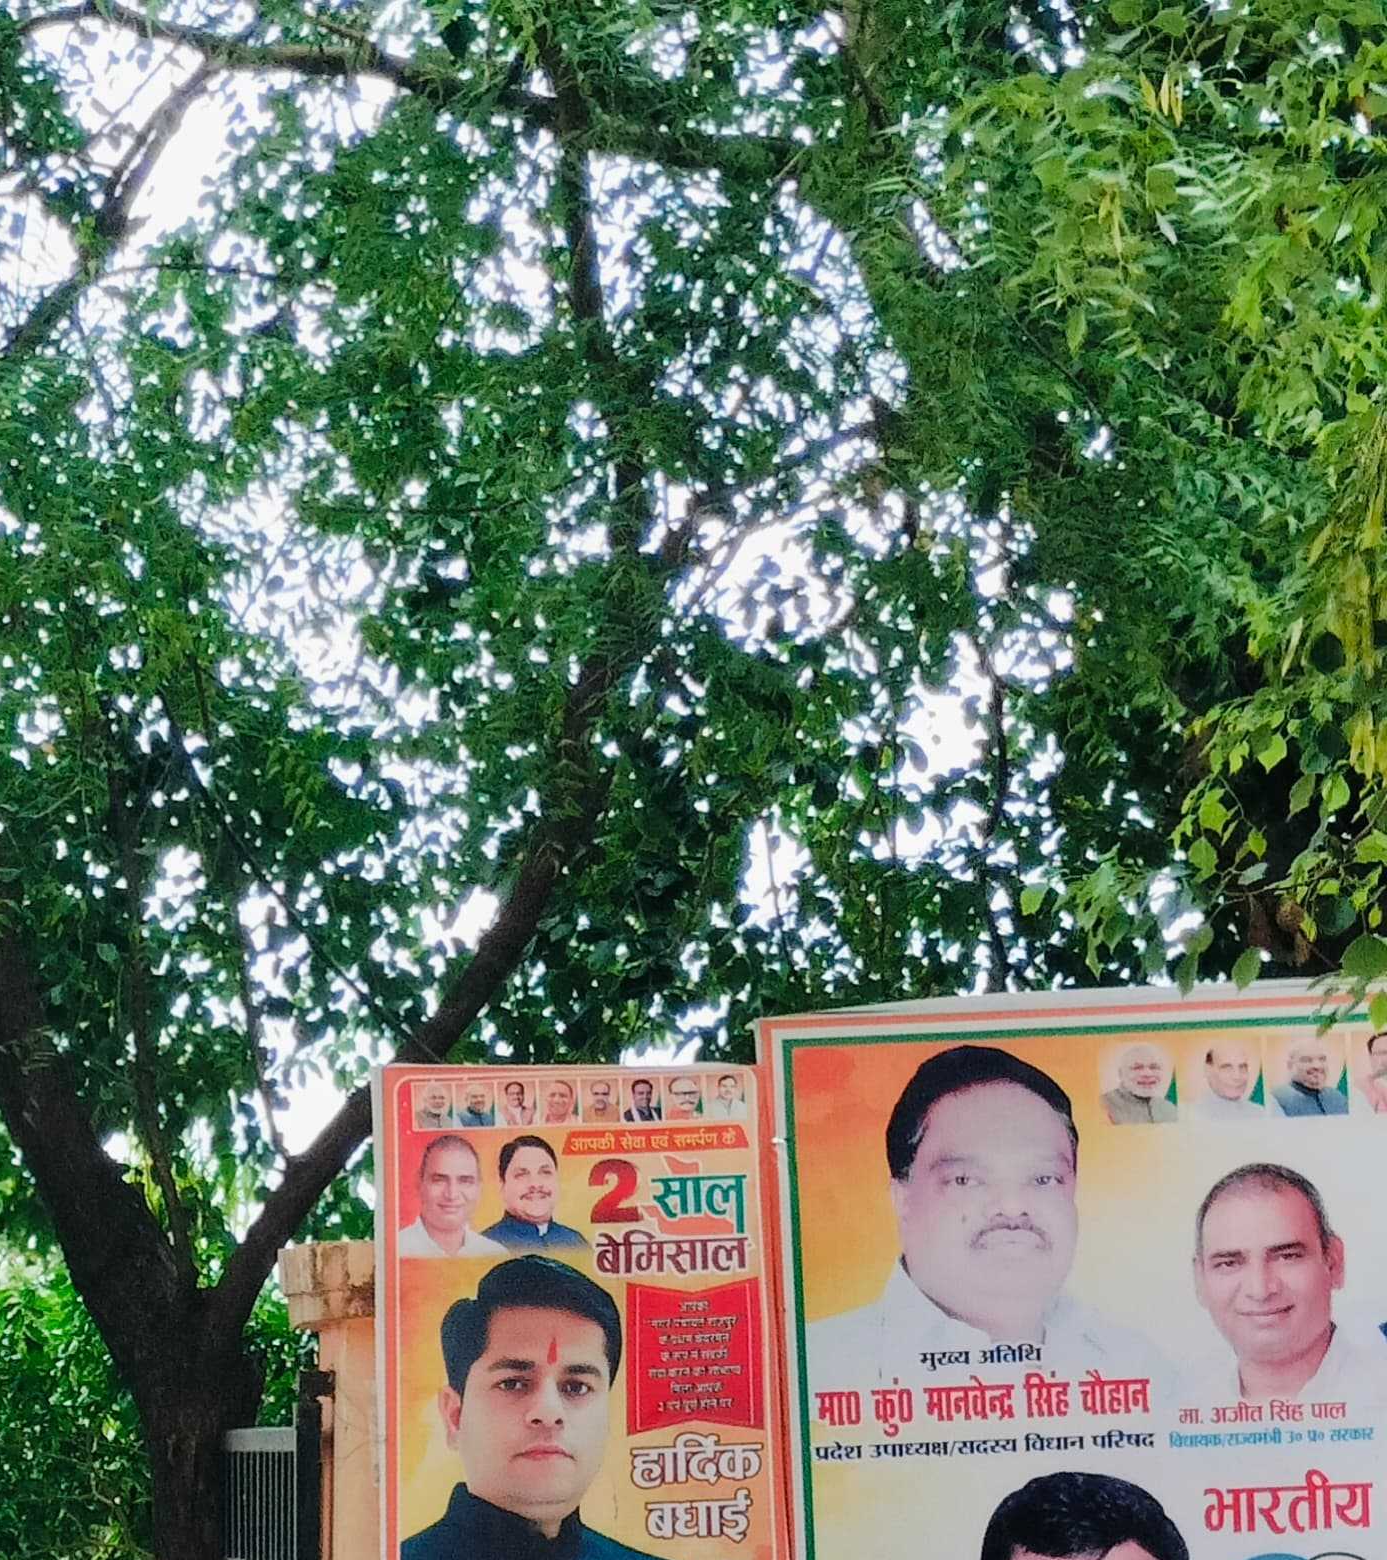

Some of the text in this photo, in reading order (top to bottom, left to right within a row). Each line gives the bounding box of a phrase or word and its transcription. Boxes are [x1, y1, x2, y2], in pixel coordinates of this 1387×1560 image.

[570, 1131, 615, 1152] आपकी
[619, 1131, 646, 1150] सेवा
[722, 1127, 737, 1145] के
[588, 1158, 748, 1234] 2 साल
[595, 1229, 749, 1274] बेमिसाल
[919, 1343, 1042, 1372] मुख्य अतिथि
[923, 1375, 1015, 1422] मानवेन्द्र
[1024, 1371, 1070, 1418] सिंह
[1078, 1369, 1151, 1416] चौहान
[1210, 1400, 1263, 1424] अजीत
[1269, 1398, 1304, 1422] सिंह
[1311, 1401, 1347, 1420] पाल
[630, 1431, 764, 1490] हार्दिक
[815, 1441, 863, 1461] प्रदेश
[1024, 1432, 1085, 1453] विधान
[1092, 1428, 1155, 1450] परिषद
[1203, 1468, 1373, 1535] भारतीय
